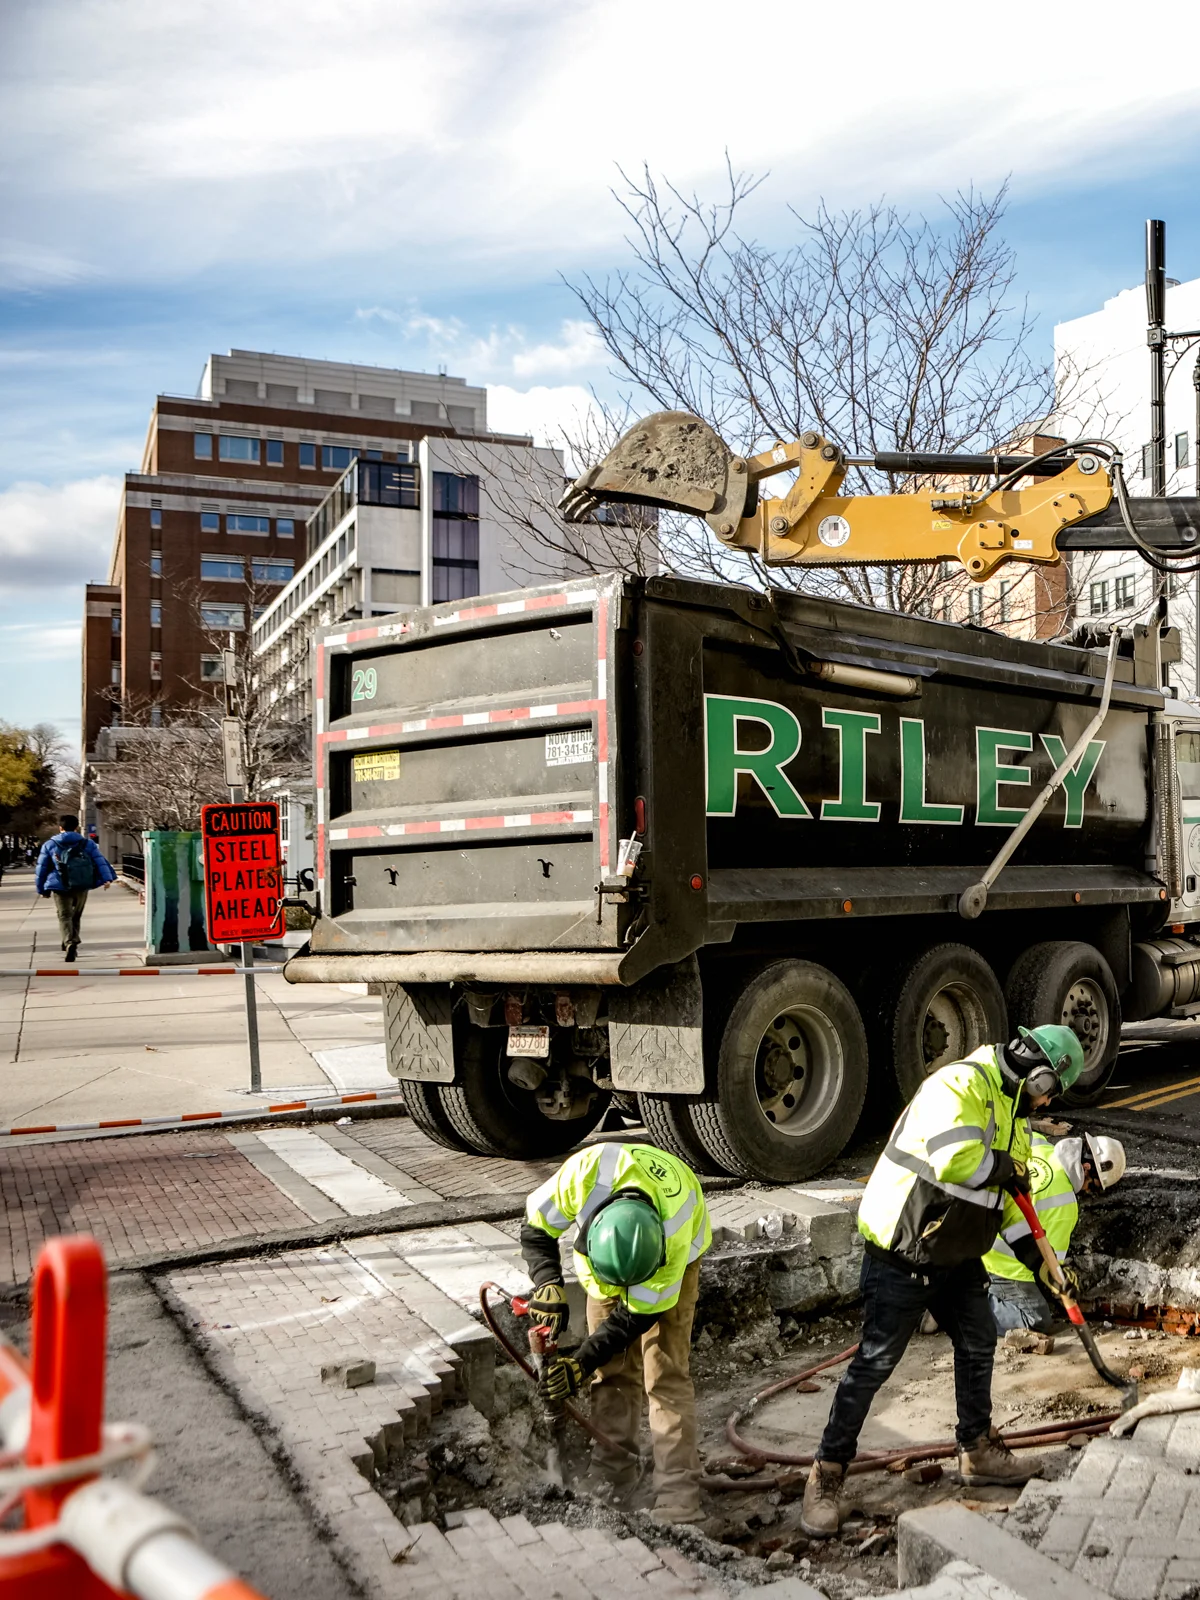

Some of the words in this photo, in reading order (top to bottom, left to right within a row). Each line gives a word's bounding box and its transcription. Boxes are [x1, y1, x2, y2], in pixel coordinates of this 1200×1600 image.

[352, 667, 377, 702] 29
[548, 732, 569, 746] NOW
[703, 693, 1107, 829] RILEY
[211, 811, 272, 831] CAUTION
[215, 840, 271, 863] STEEL
[212, 871, 276, 892] PLATES
[214, 897, 277, 920] AHEAD
